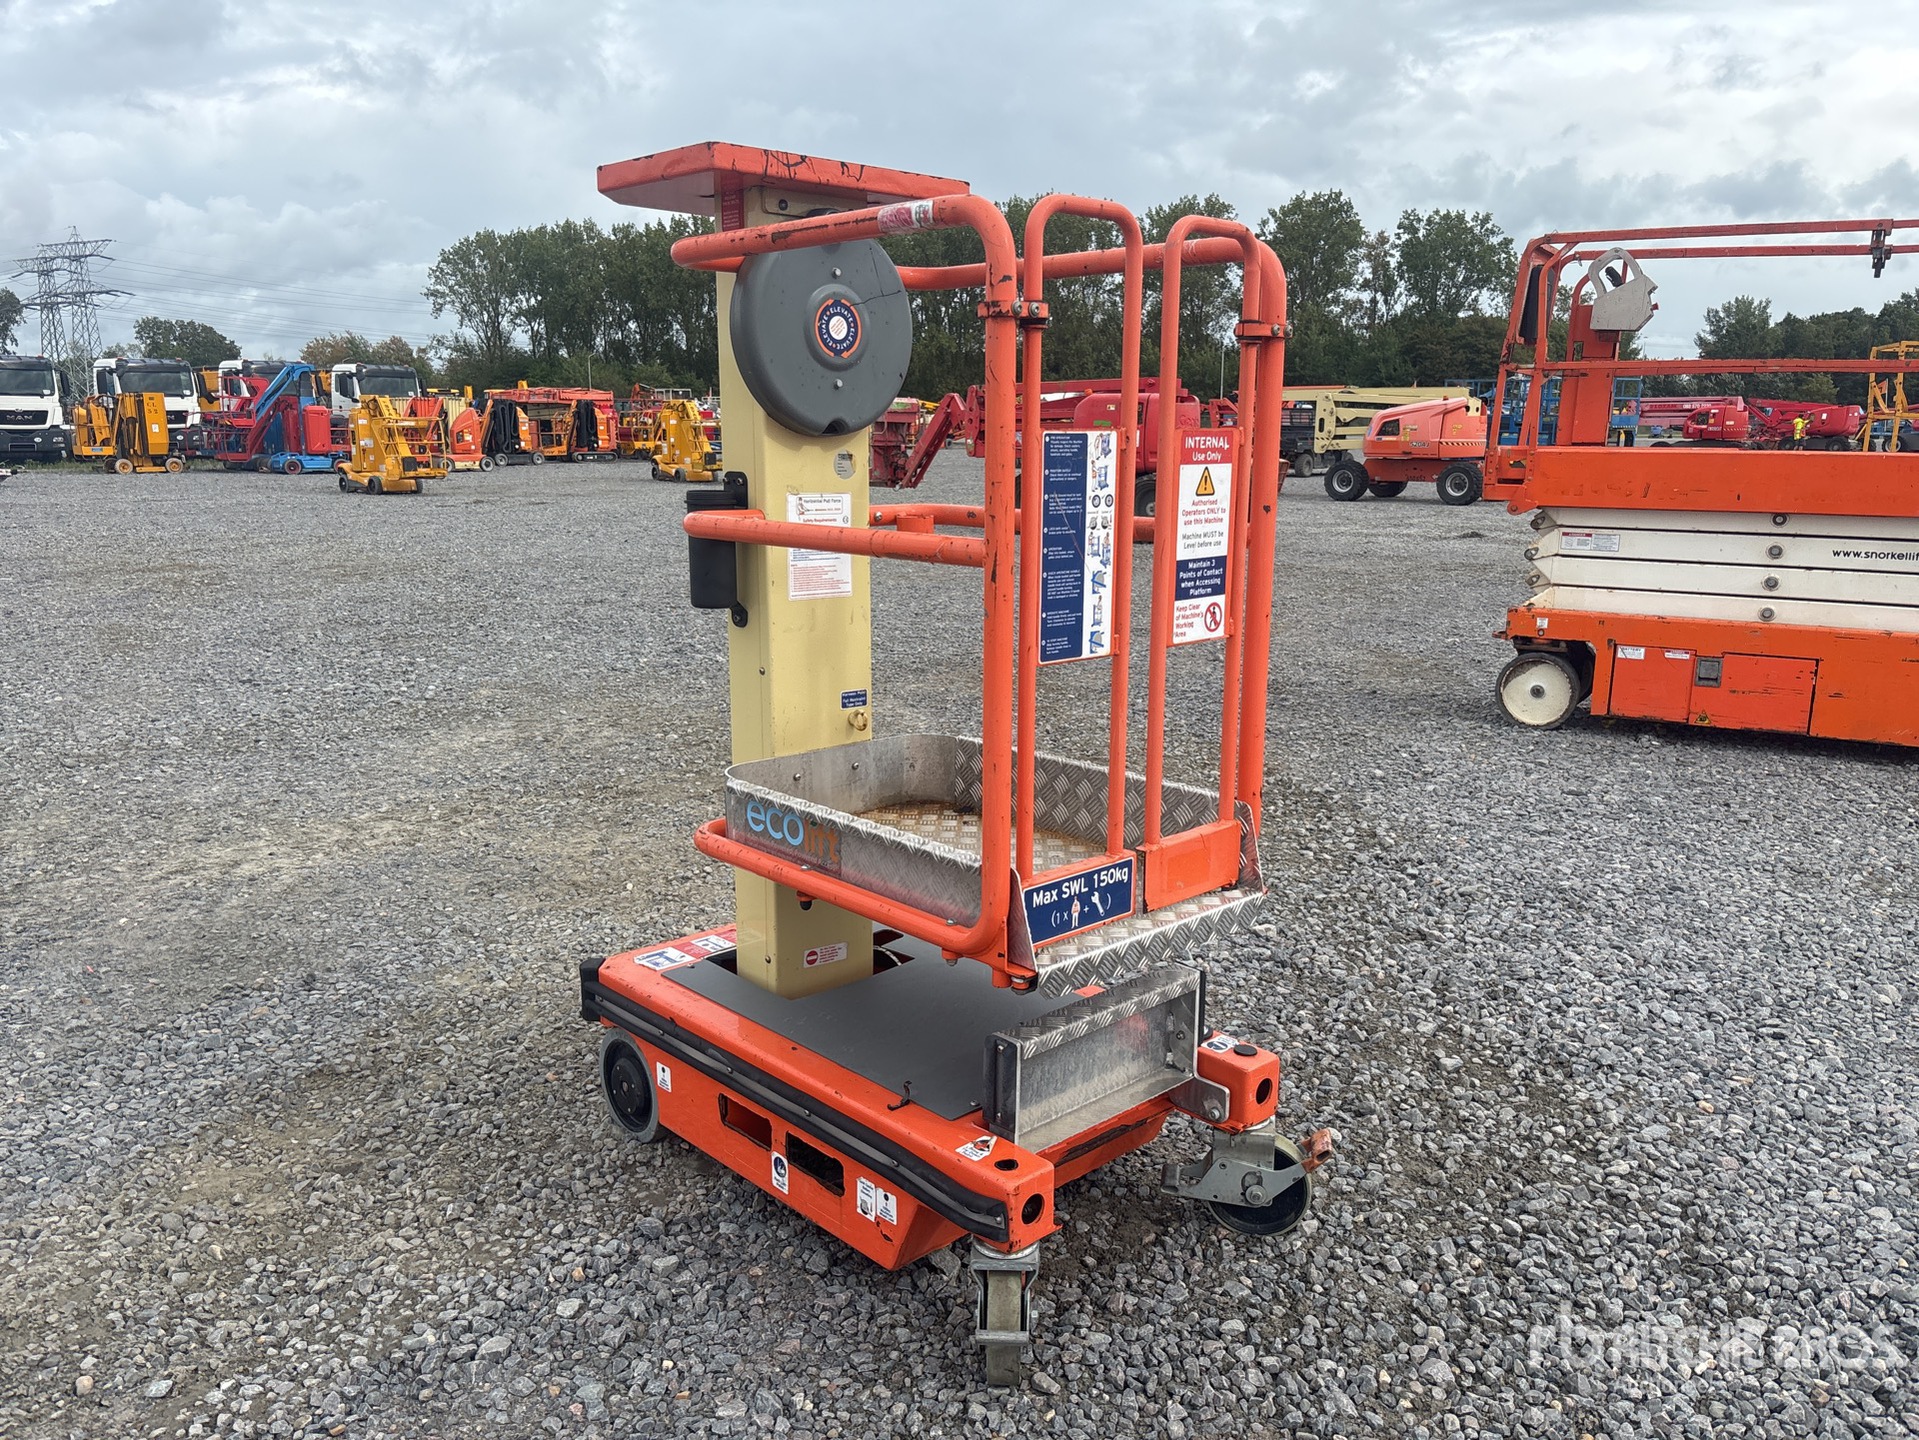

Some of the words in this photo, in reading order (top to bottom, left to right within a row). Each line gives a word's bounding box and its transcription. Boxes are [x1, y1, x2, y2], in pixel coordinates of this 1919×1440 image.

[830, 306, 853, 322] ELEVATE
[821, 314, 833, 347] ELEVATE
[836, 328, 855, 350] ELEVATE
[1185, 436, 1229, 450] INTERNAL
[1192, 452, 1205, 461] Use
[1206, 451, 1222, 462] Only
[1182, 509, 1206, 517] Operators
[1182, 532, 1202, 540] Machine
[1203, 530, 1217, 539] MUST
[1183, 541, 1197, 549] Level
[1197, 540, 1212, 548] before
[1188, 559, 1210, 569] Maintain
[1211, 559, 1216, 567] 3
[1179, 571, 1196, 579] Points
[1197, 569, 1202, 577] of
[1203, 567, 1223, 577] Contact
[1181, 579, 1194, 588] when
[1195, 577, 1221, 587] Accessing
[1189, 587, 1212, 596] Platform
[1176, 604, 1188, 613] Keep
[1033, 889, 1058, 908] Max
[1062, 877, 1088, 898] SWL
[1093, 866, 1129, 888] 150kg
